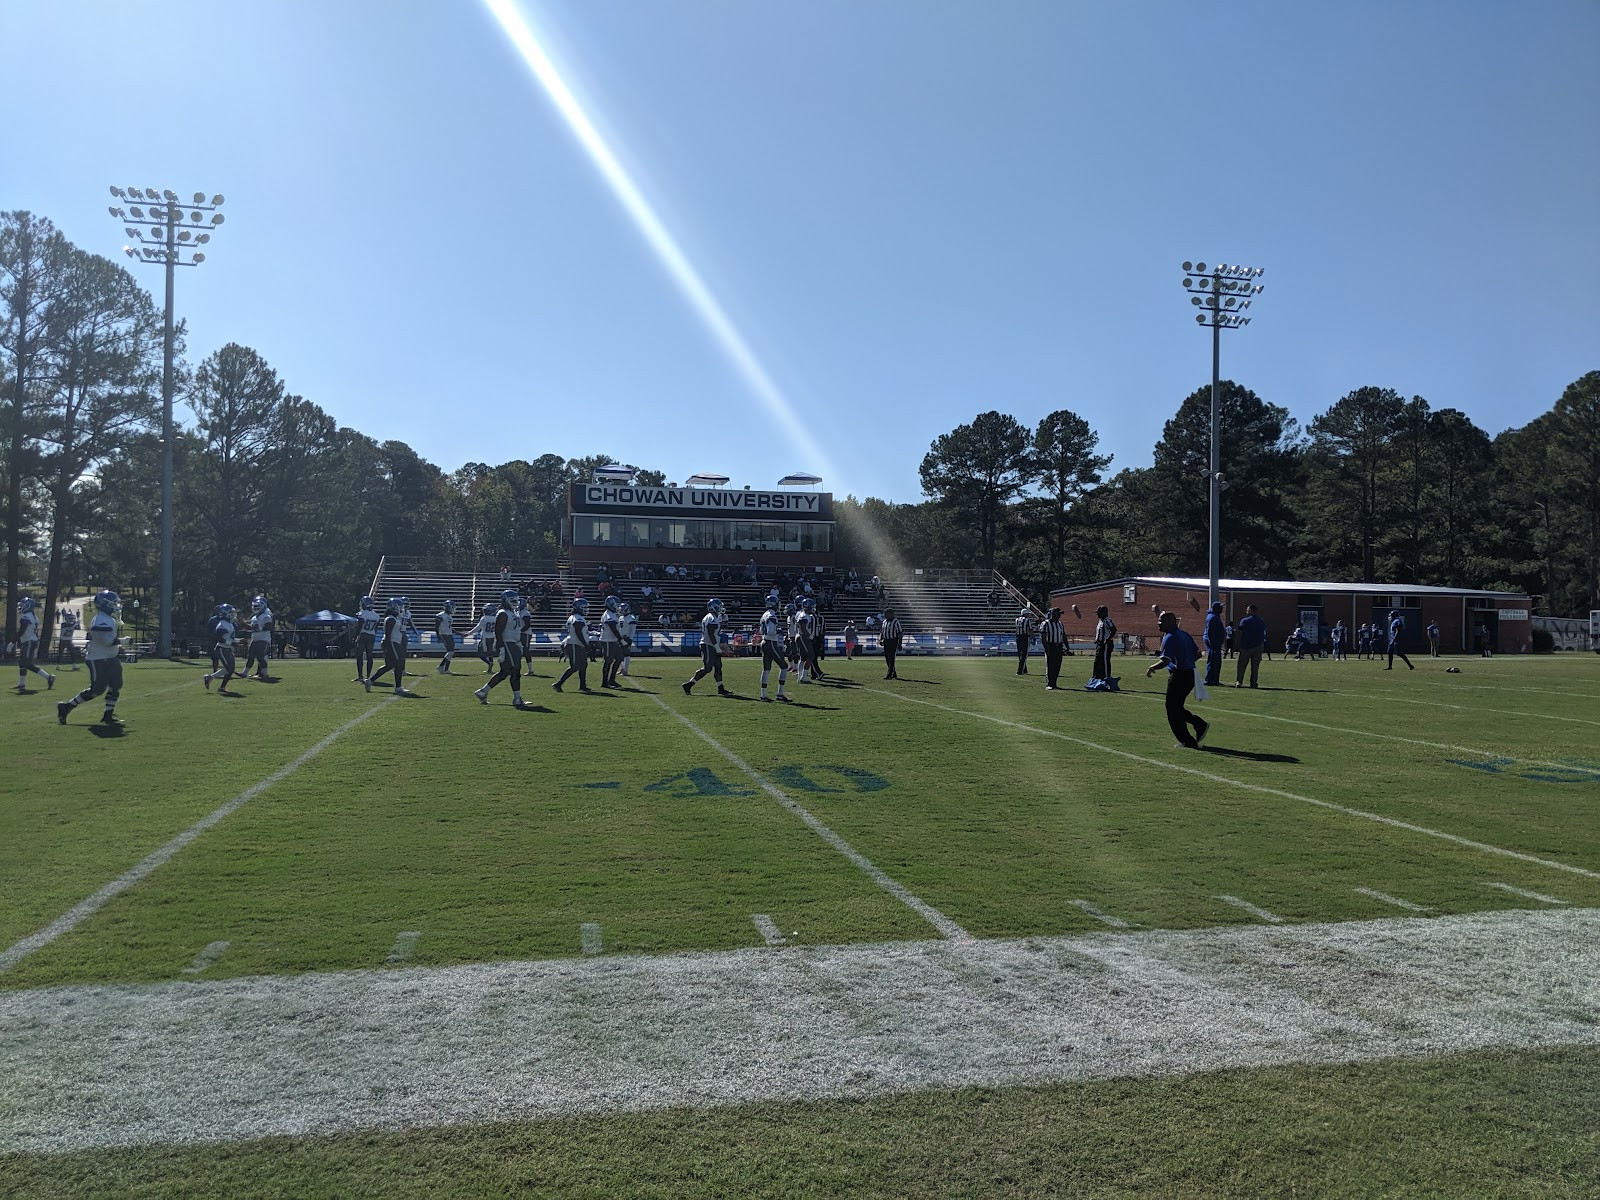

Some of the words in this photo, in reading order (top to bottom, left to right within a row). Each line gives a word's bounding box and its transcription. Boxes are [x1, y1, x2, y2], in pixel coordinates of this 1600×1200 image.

[587, 487, 684, 505] CHOWAN
[691, 491, 818, 511] UNIVERSITY
[363, 619, 377, 631] 87
[643, 764, 892, 799] 40
